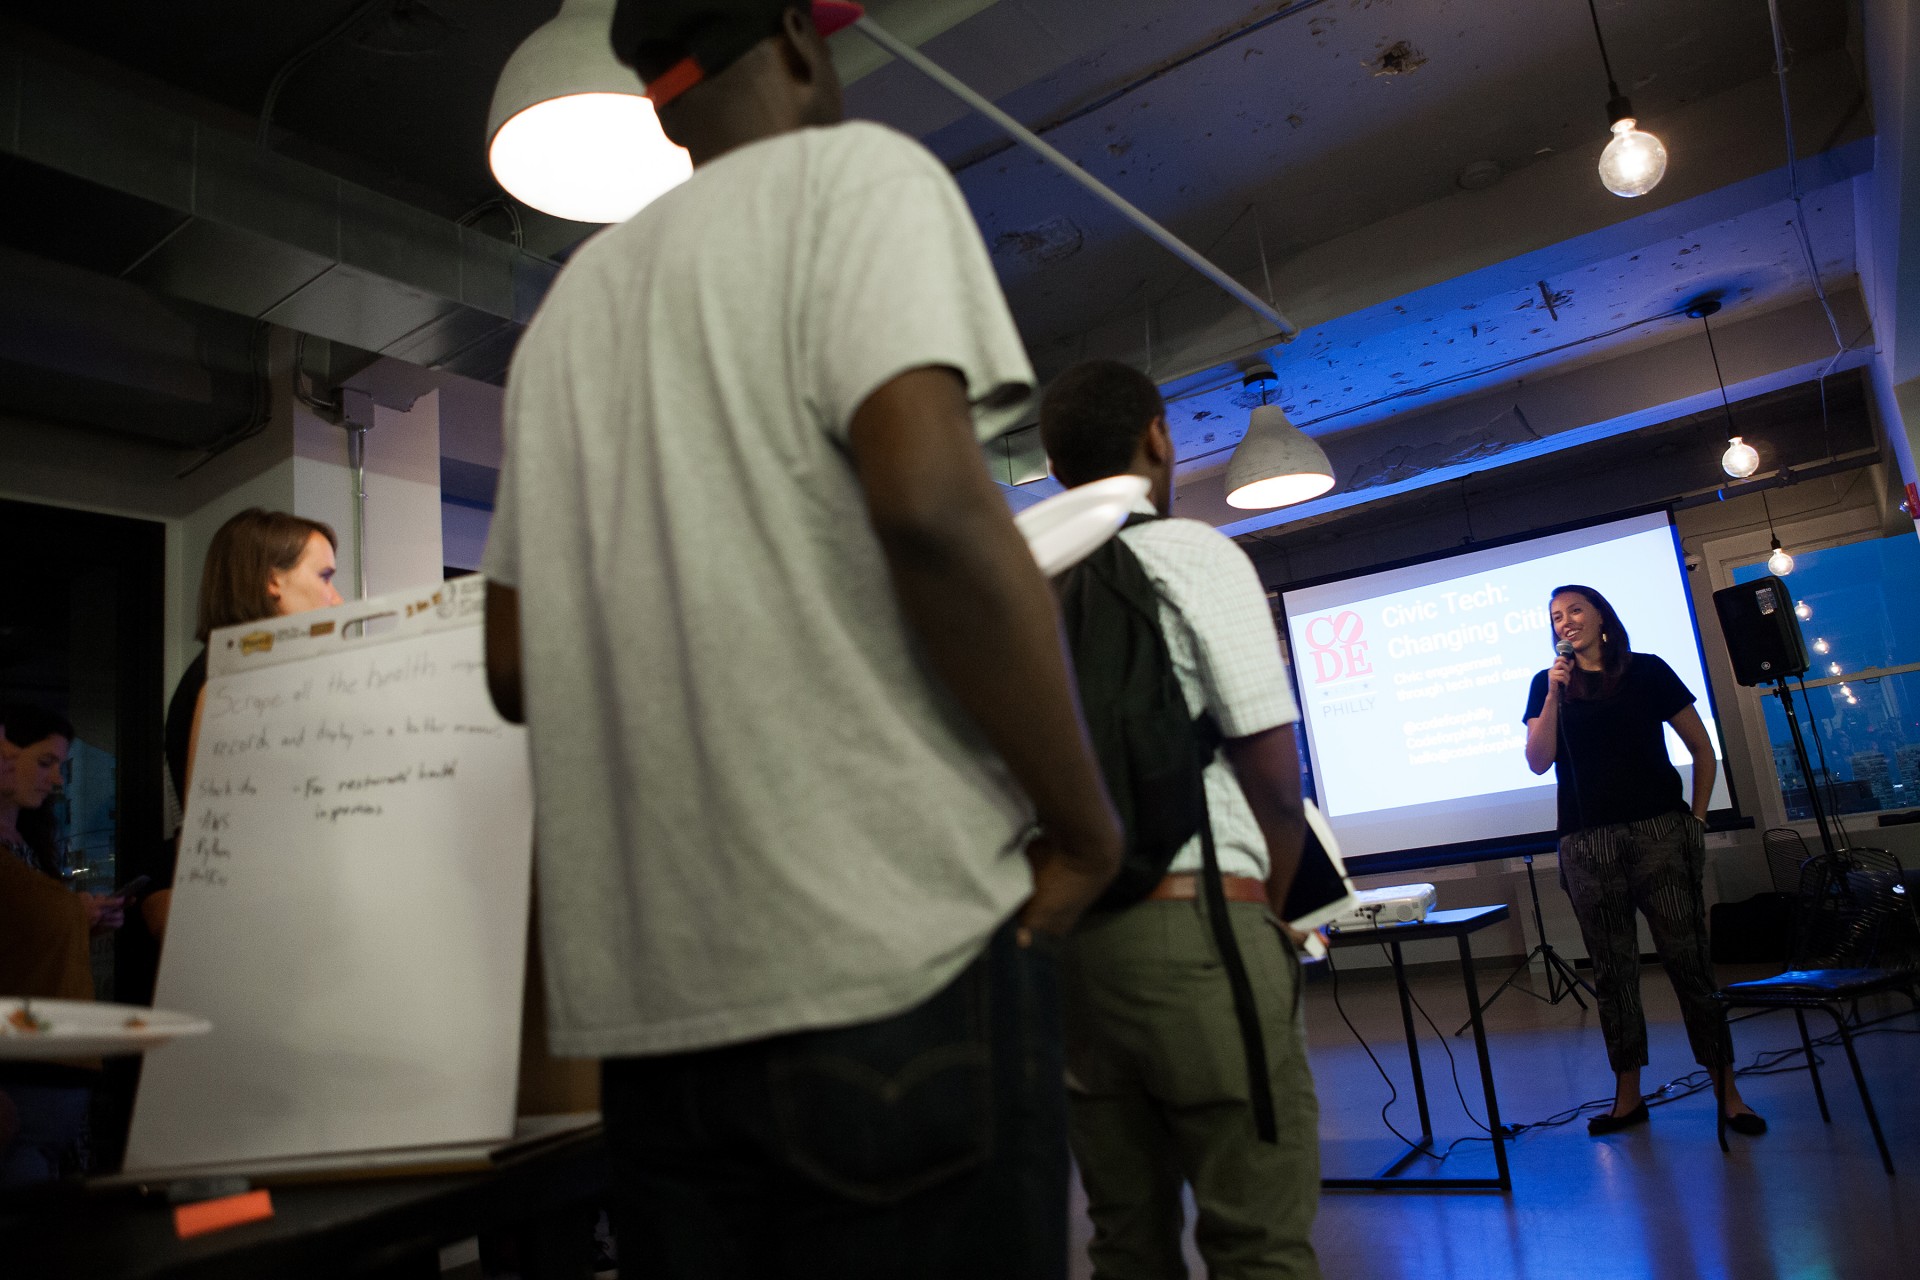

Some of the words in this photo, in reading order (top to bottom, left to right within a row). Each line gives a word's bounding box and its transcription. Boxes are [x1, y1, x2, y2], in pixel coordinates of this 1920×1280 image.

[1383, 601, 1439, 627] Civic
[1441, 583, 1511, 614] Tech:
[1389, 621, 1499, 659] Changing
[1395, 672, 1424, 685] Civic
[1425, 655, 1503, 679] engagement
[1397, 683, 1445, 701] through
[1445, 678, 1473, 691] tech
[1476, 673, 1501, 686] and
[1502, 669, 1532, 681] data
[1323, 696, 1377, 719] PHILLY
[1404, 709, 1493, 736] @codeforphilly
